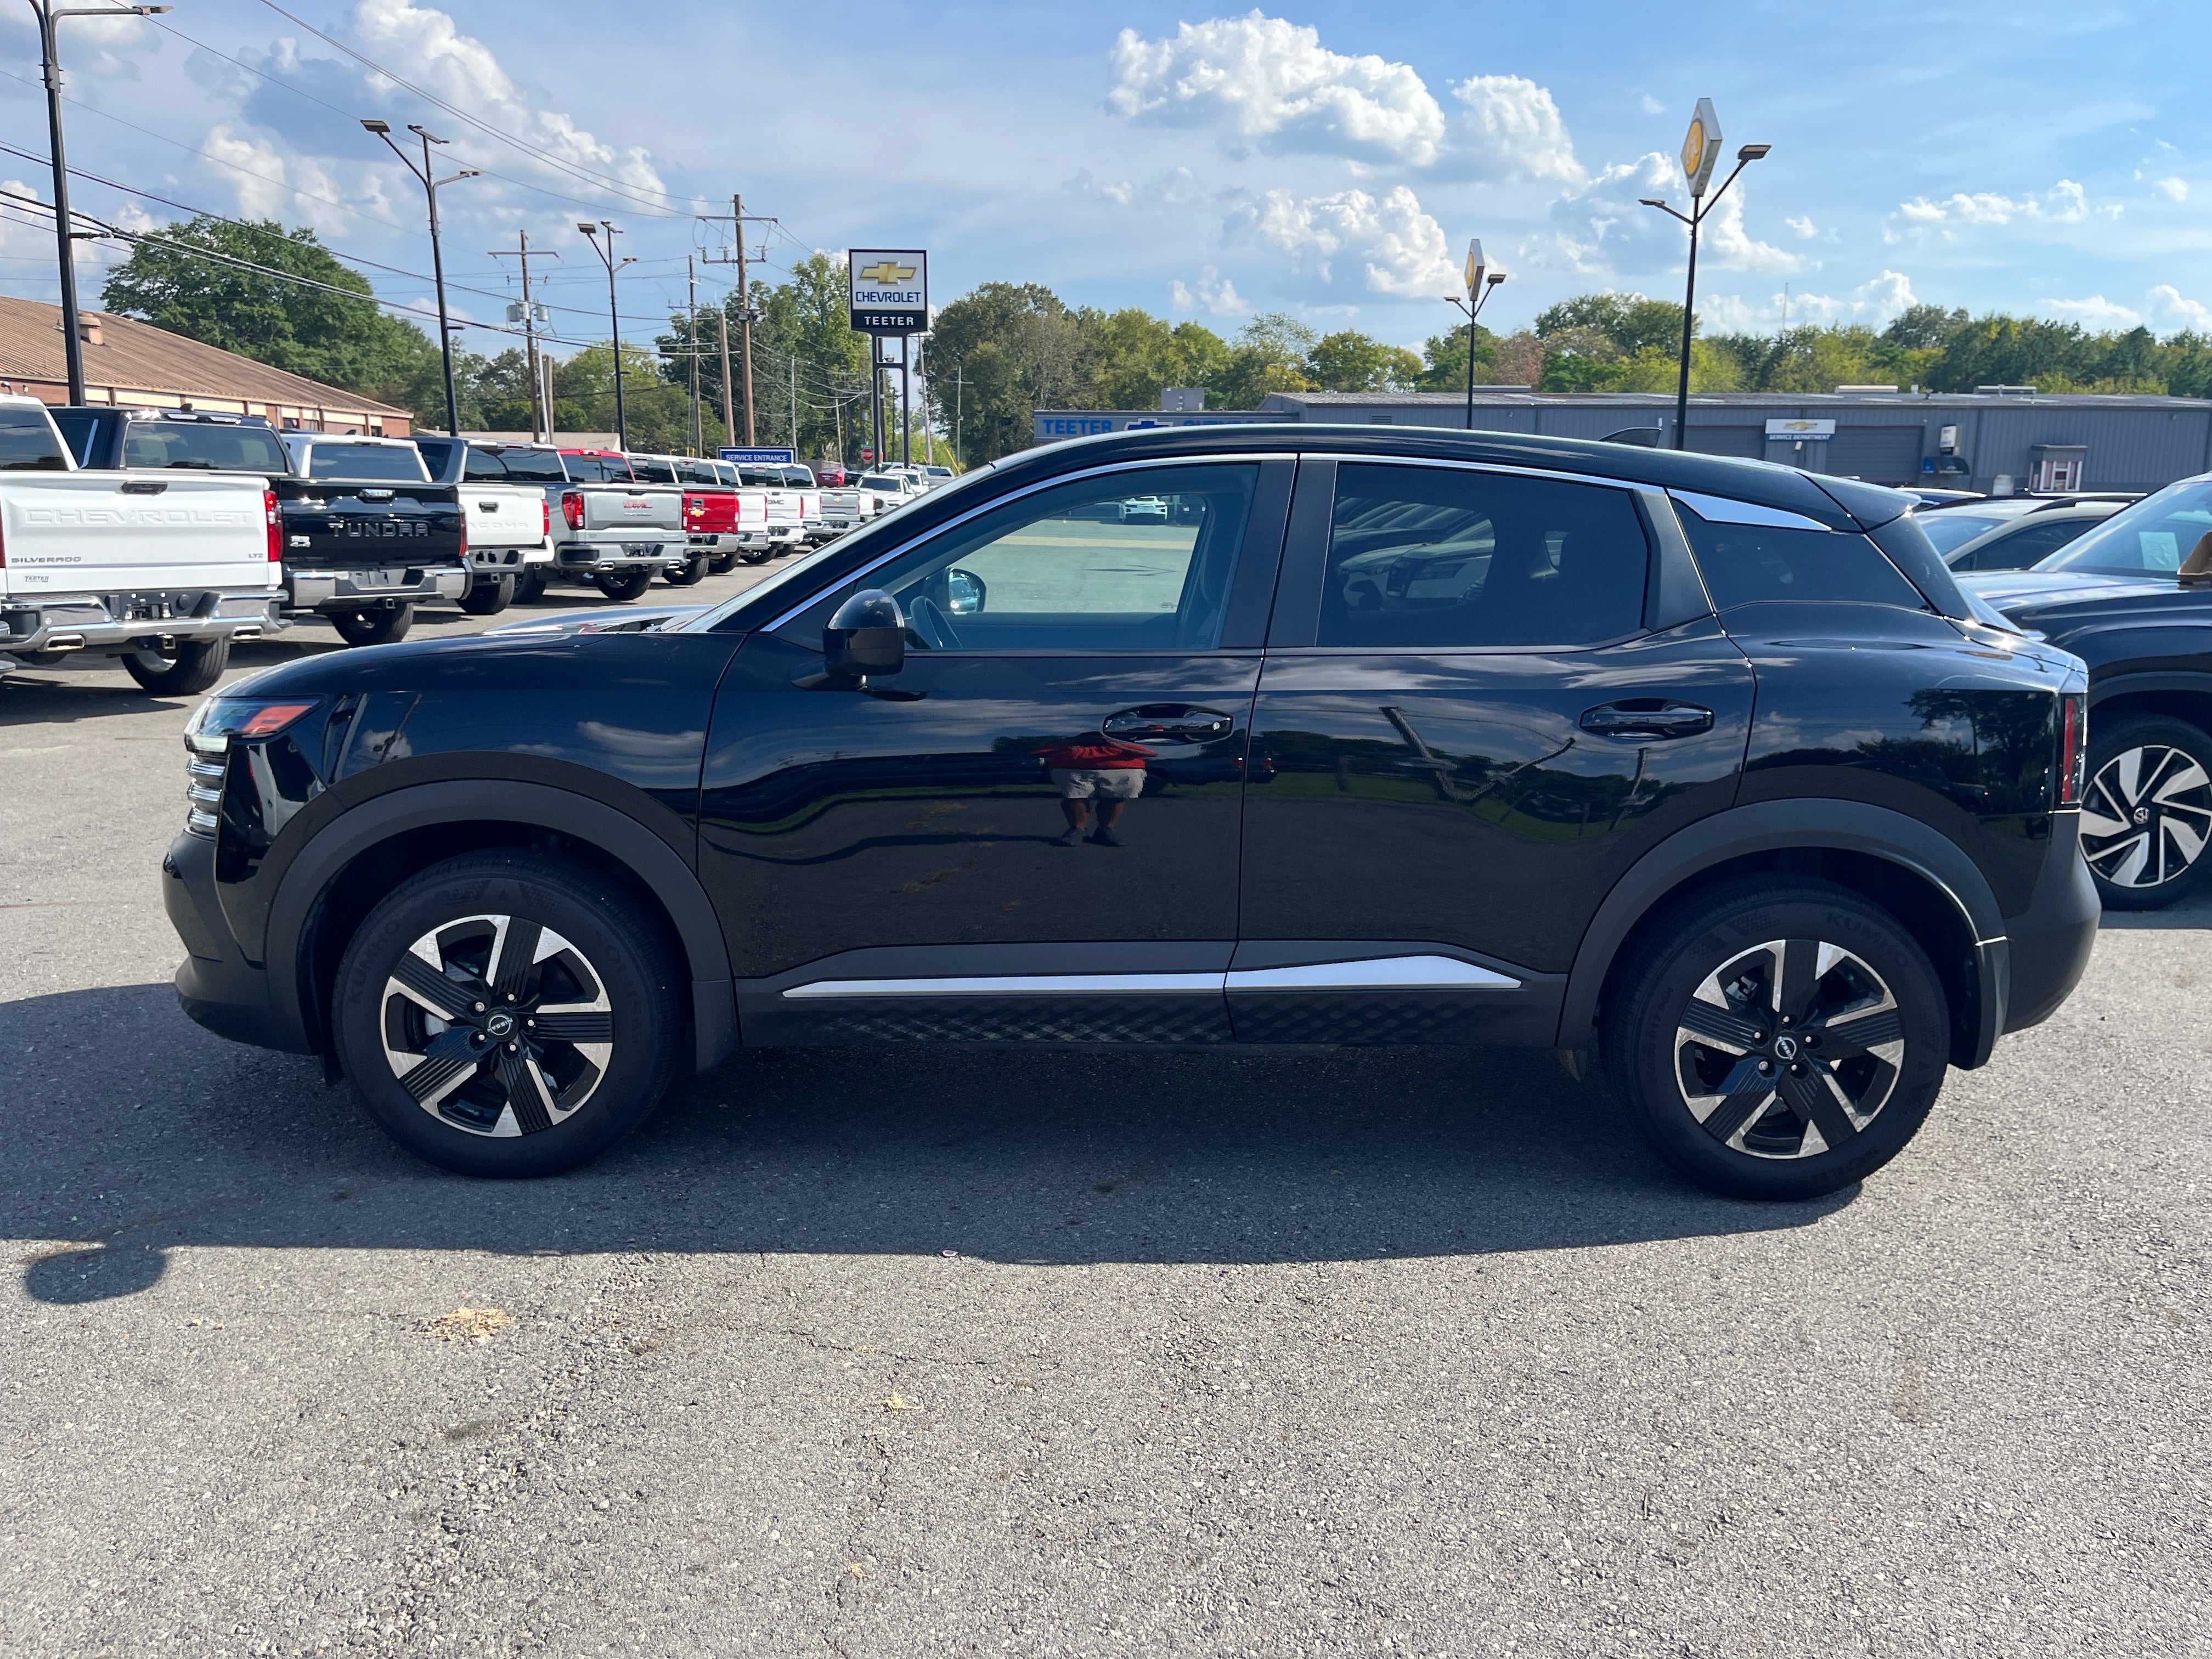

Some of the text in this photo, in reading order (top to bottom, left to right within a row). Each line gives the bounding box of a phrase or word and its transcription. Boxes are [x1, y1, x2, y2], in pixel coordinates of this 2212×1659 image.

[855, 291, 921, 303] CHEVROLET
[864, 316, 914, 325] TEETER
[1043, 419, 1113, 435] TEETER
[624, 500, 653, 509] GMC
[25, 509, 254, 525] CHEVROLET
[328, 522, 429, 538] TUNDRA
[466, 522, 528, 531] ACOMA
[1825, 912, 1909, 969] KUMHO
[487, 1018, 514, 1032] NISSAN
